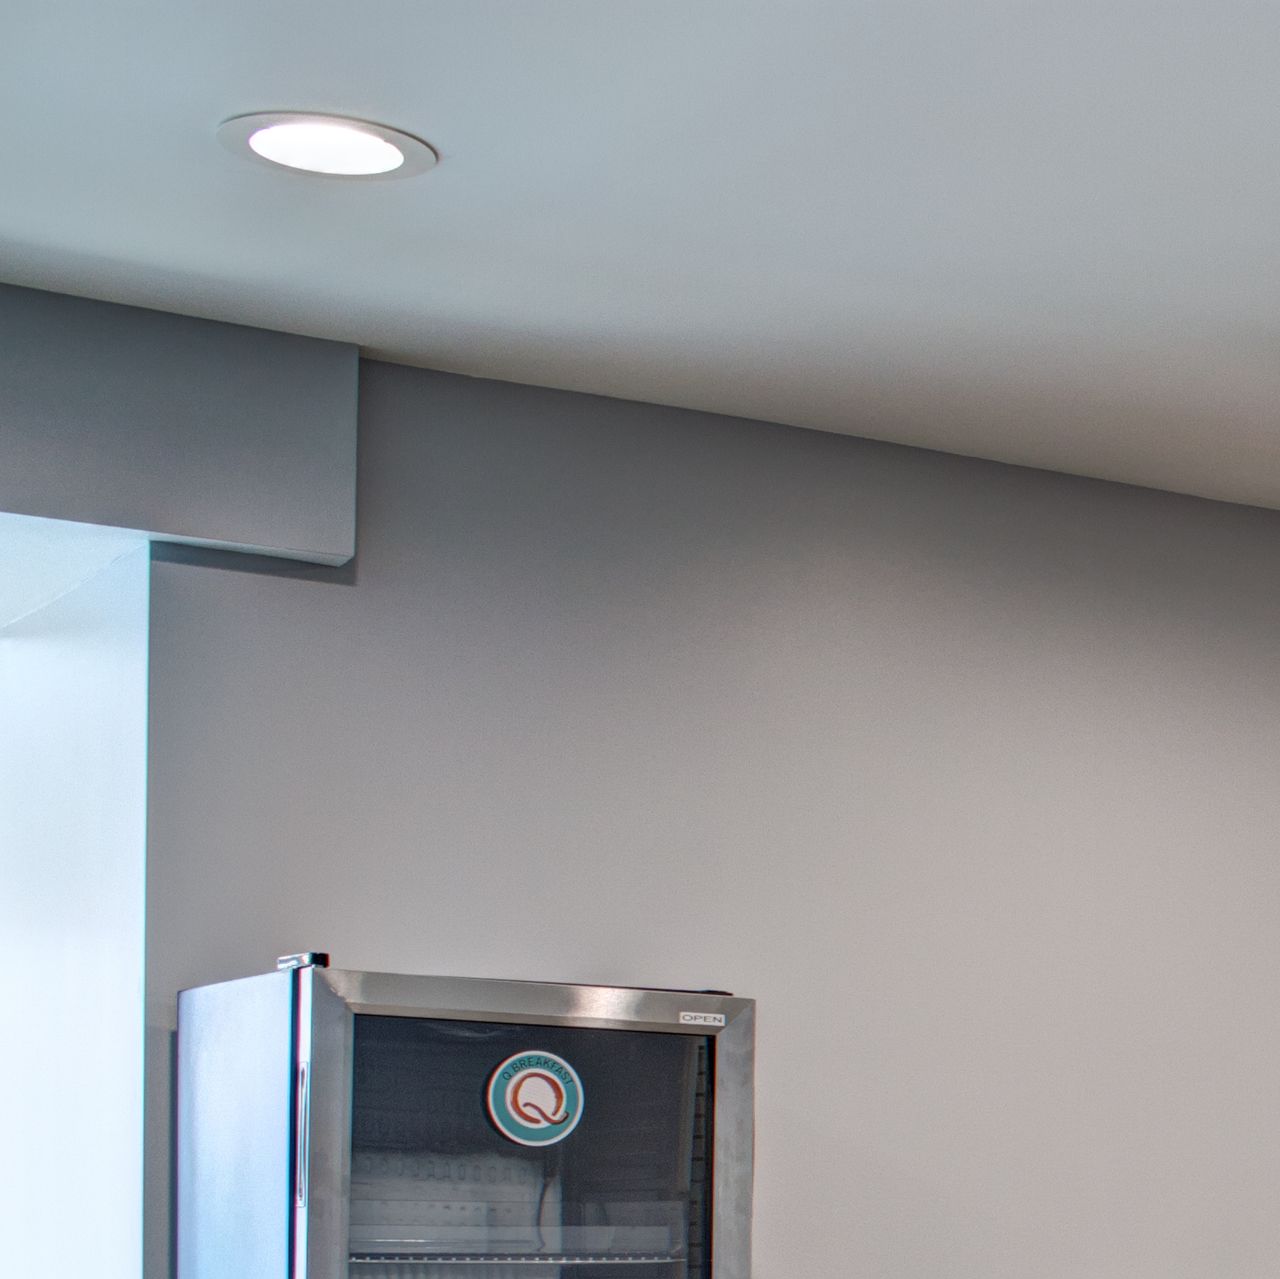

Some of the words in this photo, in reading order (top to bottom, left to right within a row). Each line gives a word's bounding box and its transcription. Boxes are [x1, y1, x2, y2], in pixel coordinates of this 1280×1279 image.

[682, 1014, 723, 1024] OPEN
[503, 1071, 513, 1081] Q
[511, 1056, 574, 1085] BREAKFAST
[511, 1072, 570, 1125] Q
